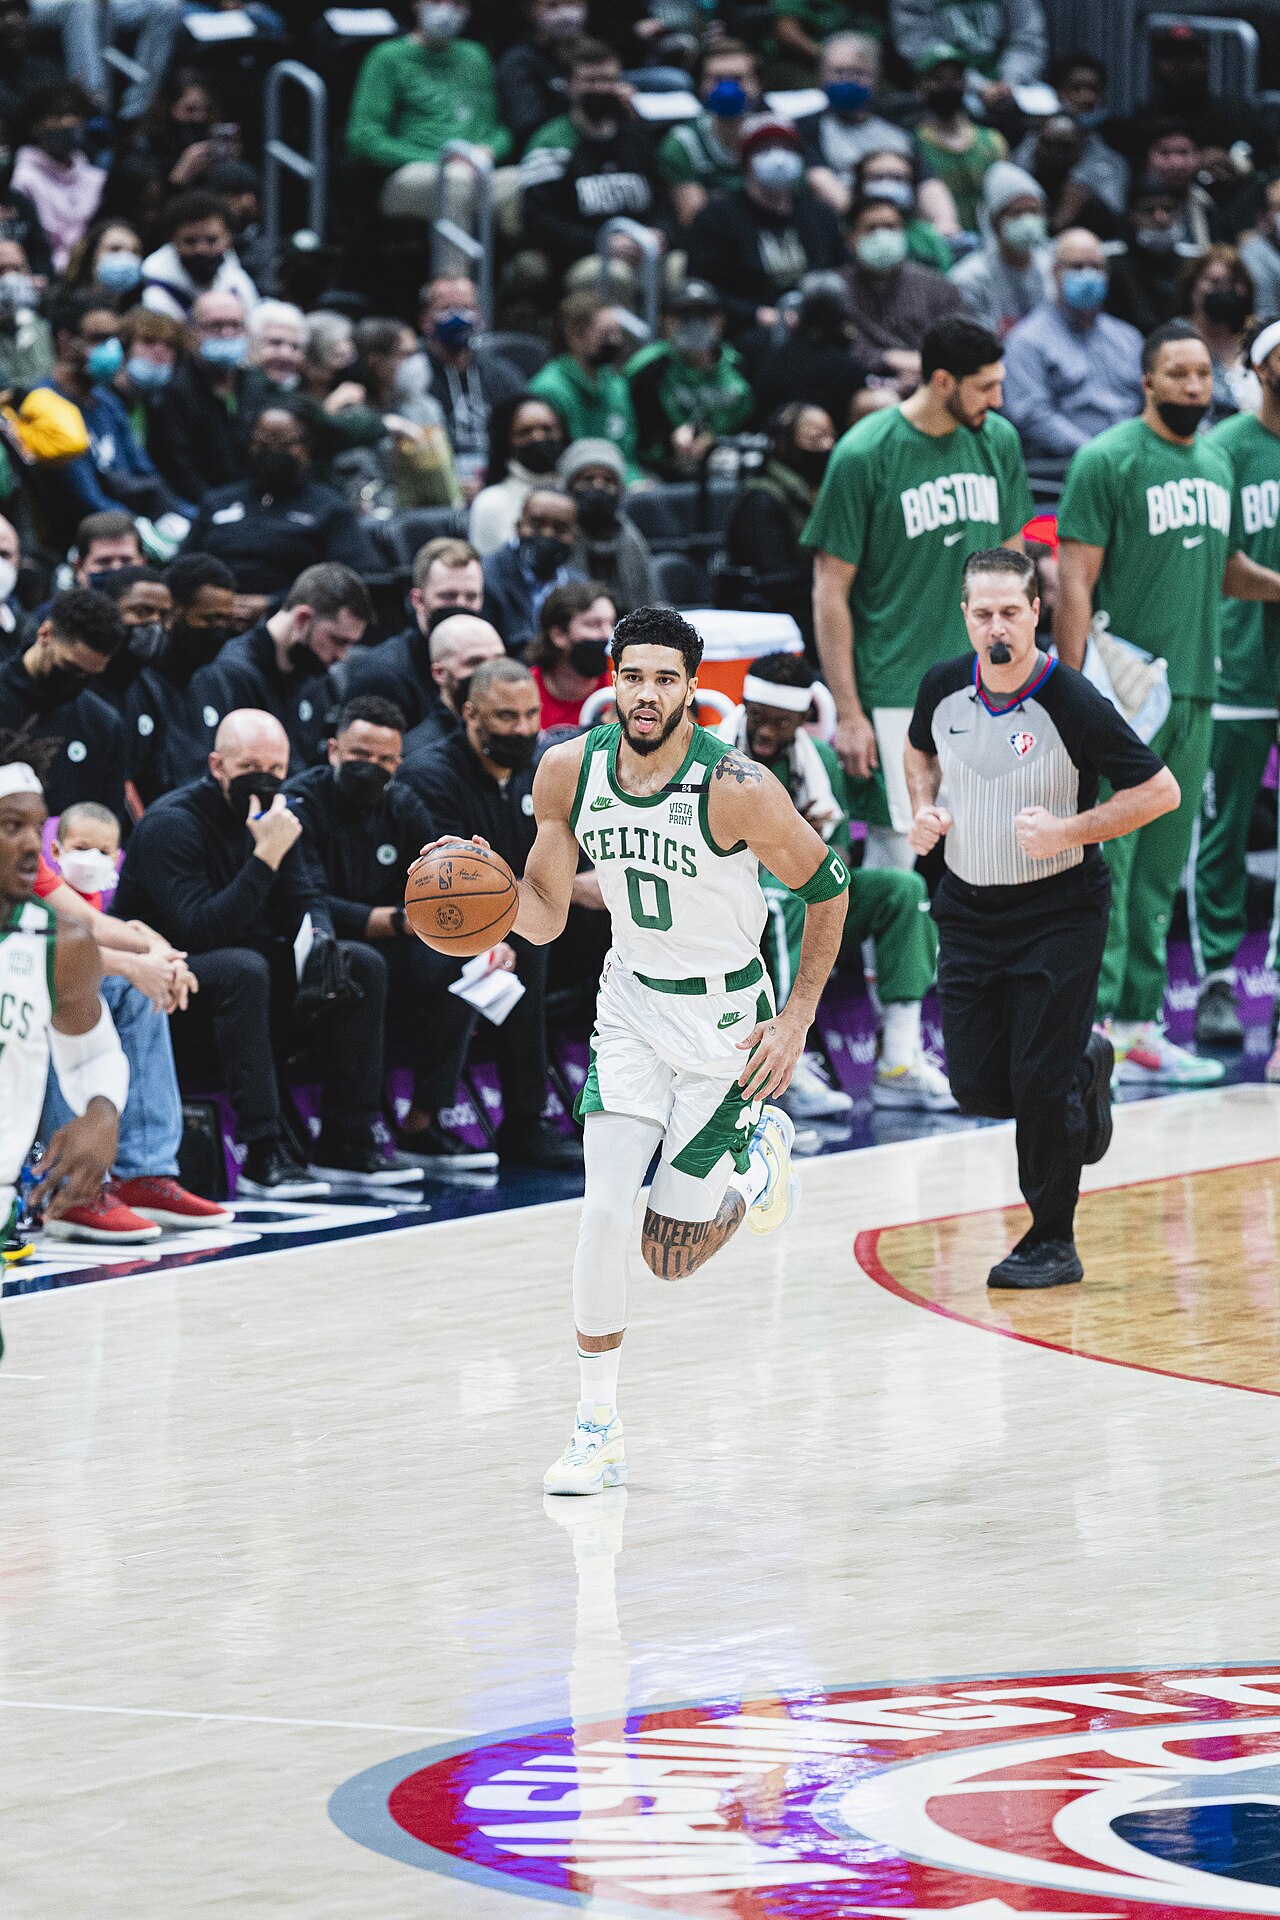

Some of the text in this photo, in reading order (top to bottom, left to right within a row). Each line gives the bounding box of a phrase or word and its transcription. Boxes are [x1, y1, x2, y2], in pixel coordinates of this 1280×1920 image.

[899, 472, 999, 539] BOSTON
[1146, 477, 1231, 537] BOSTON
[681, 784, 692, 793] 24
[594, 795, 613, 806] NIKE
[669, 802, 693, 817] VISTA
[668, 814, 693, 826] PRINT
[582, 826, 698, 878] CELTICS
[623, 866, 673, 932] 0
[721, 1011, 741, 1023] NIKE
